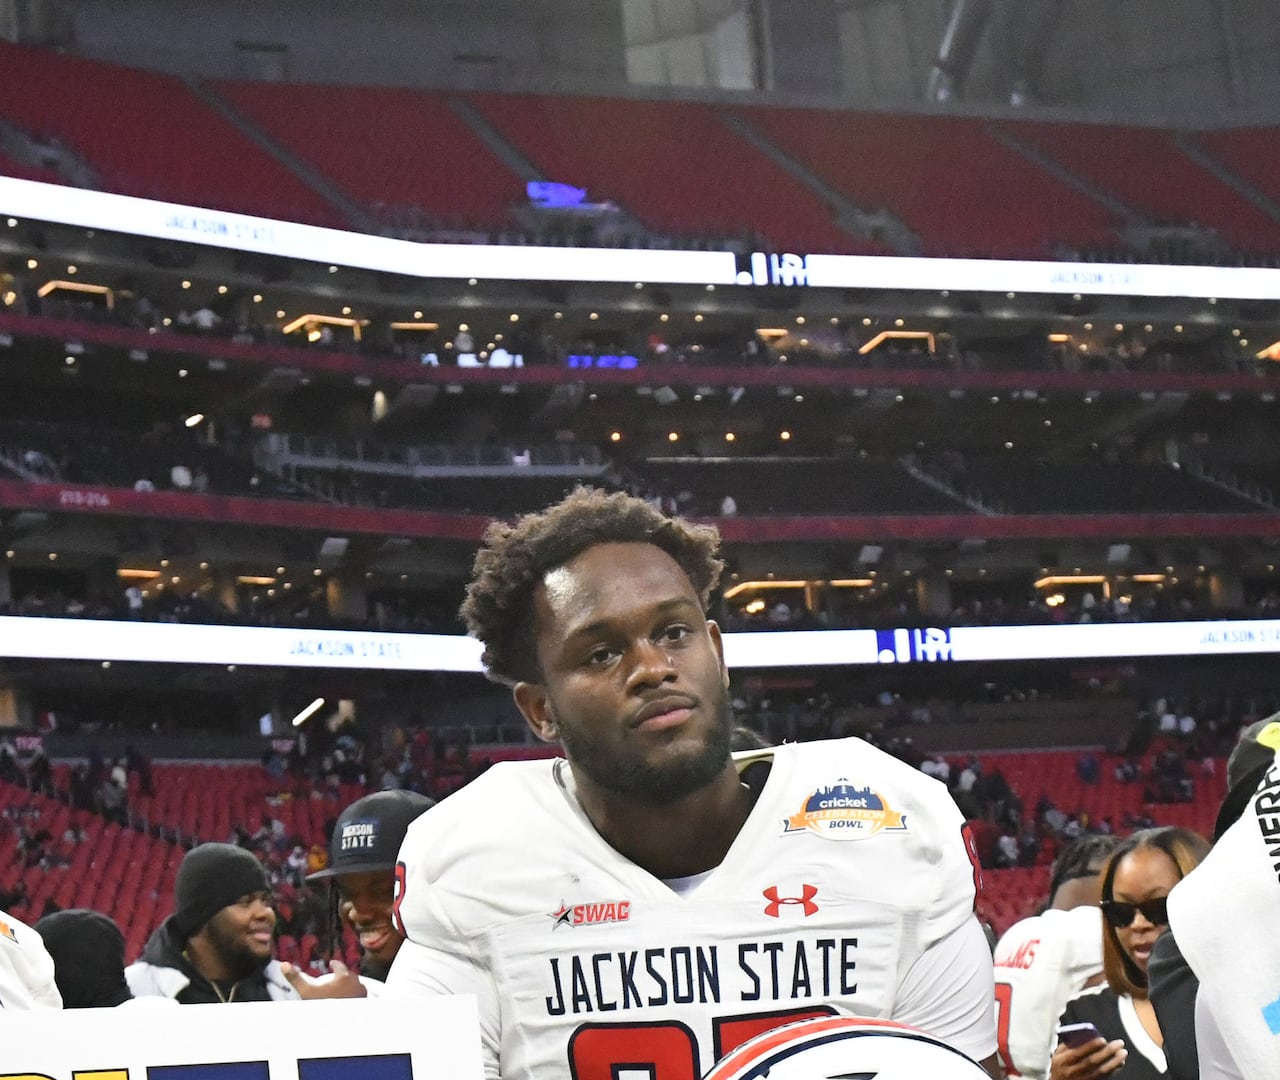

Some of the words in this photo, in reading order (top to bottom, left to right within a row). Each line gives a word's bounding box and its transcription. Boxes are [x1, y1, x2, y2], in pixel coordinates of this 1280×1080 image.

[818, 797, 868, 809] cricket
[828, 820, 864, 829] BOWL
[341, 835, 376, 850] STATE
[573, 900, 631, 926] SWAC
[545, 945, 721, 1016] JACKSON
[738, 937, 858, 1001] STATE
